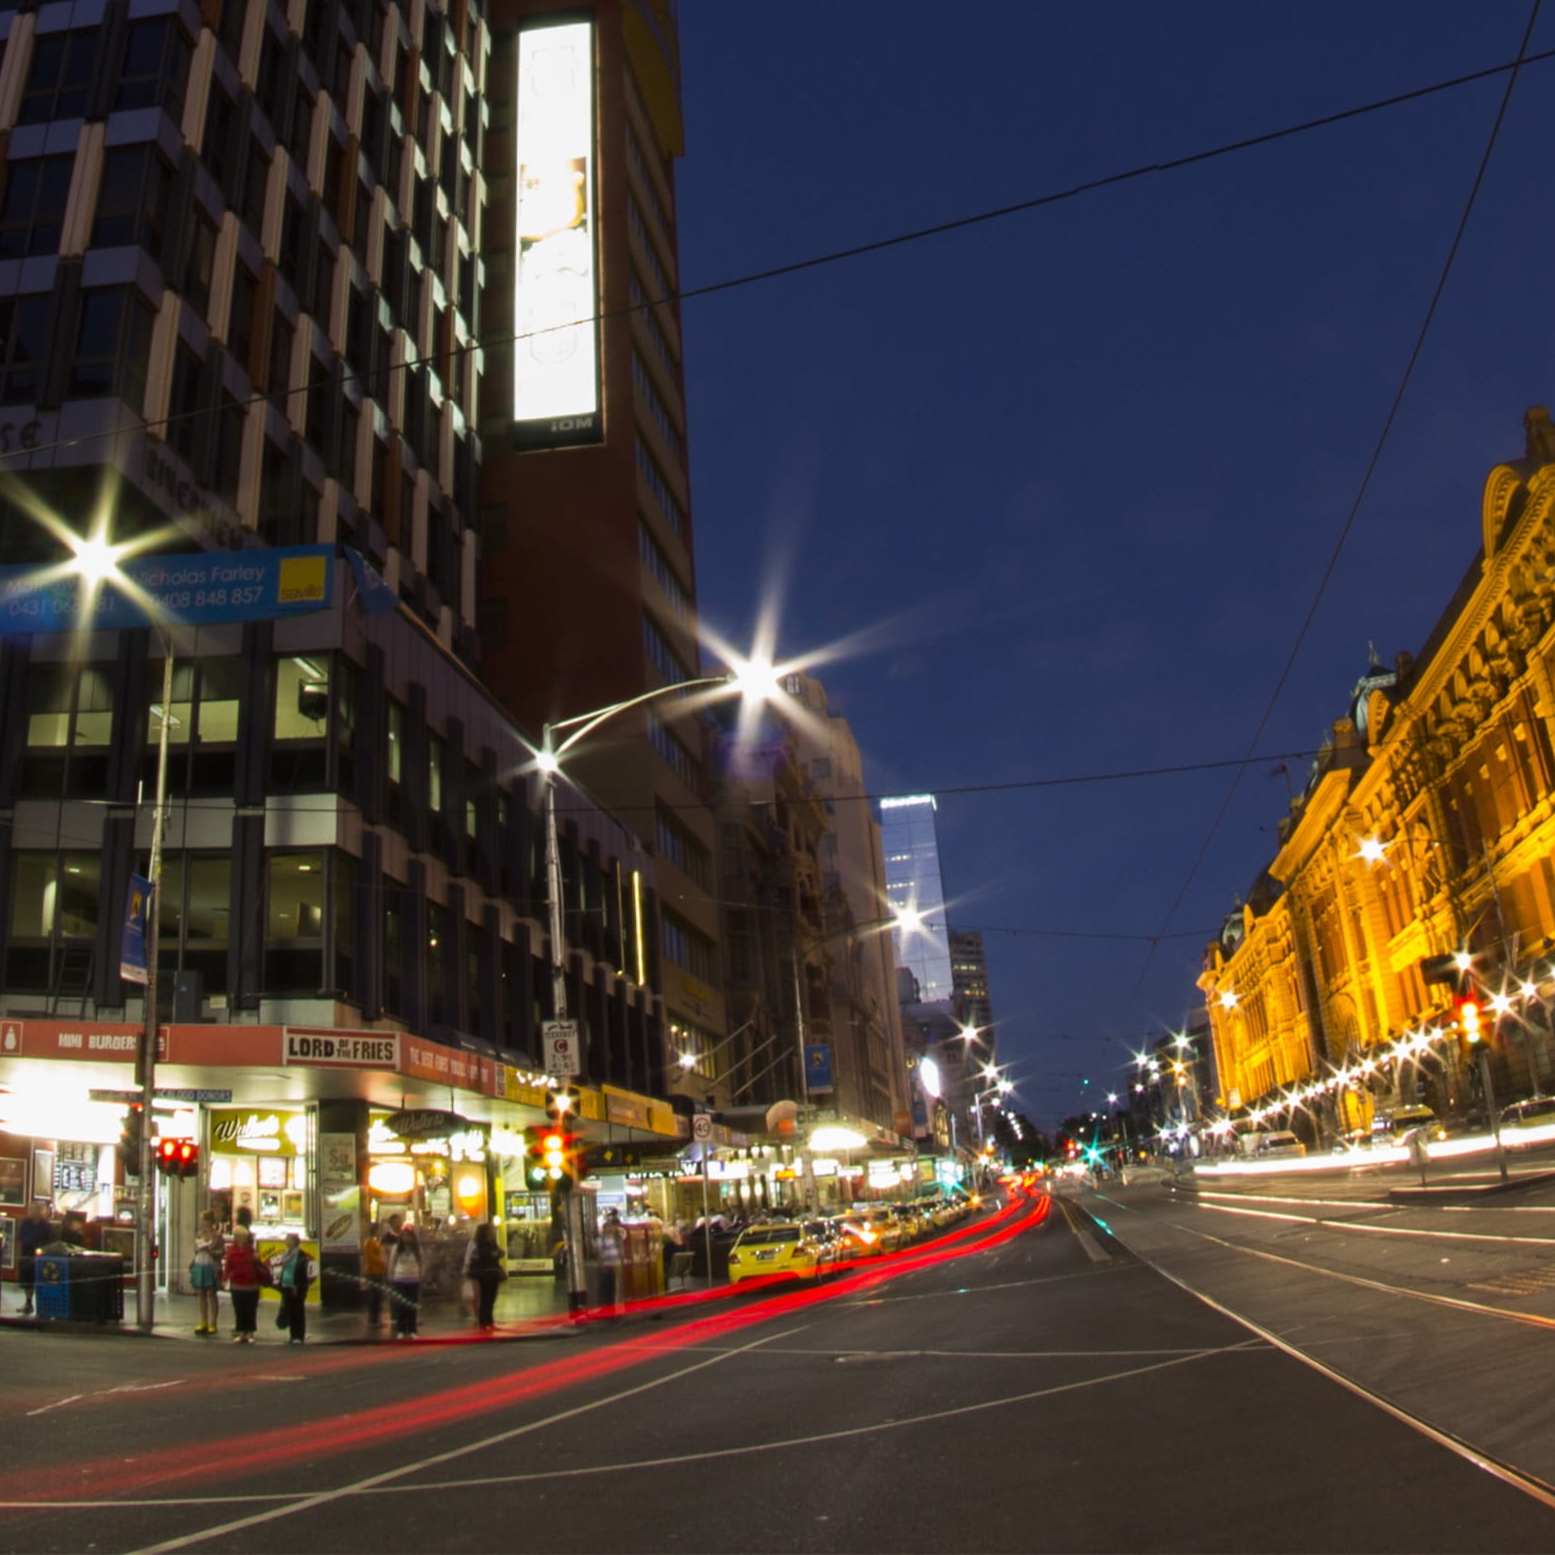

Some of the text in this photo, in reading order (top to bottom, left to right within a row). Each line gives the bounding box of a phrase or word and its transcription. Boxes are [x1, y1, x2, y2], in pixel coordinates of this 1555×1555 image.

[129, 565, 266, 589] Nicholas Farley
[195, 588, 227, 608] 848
[232, 585, 265, 605] 857
[58, 1032, 82, 1049] MINI
[288, 1036, 335, 1058] LORD
[352, 1040, 394, 1061] FRIES
[695, 1120, 710, 1133] 40
